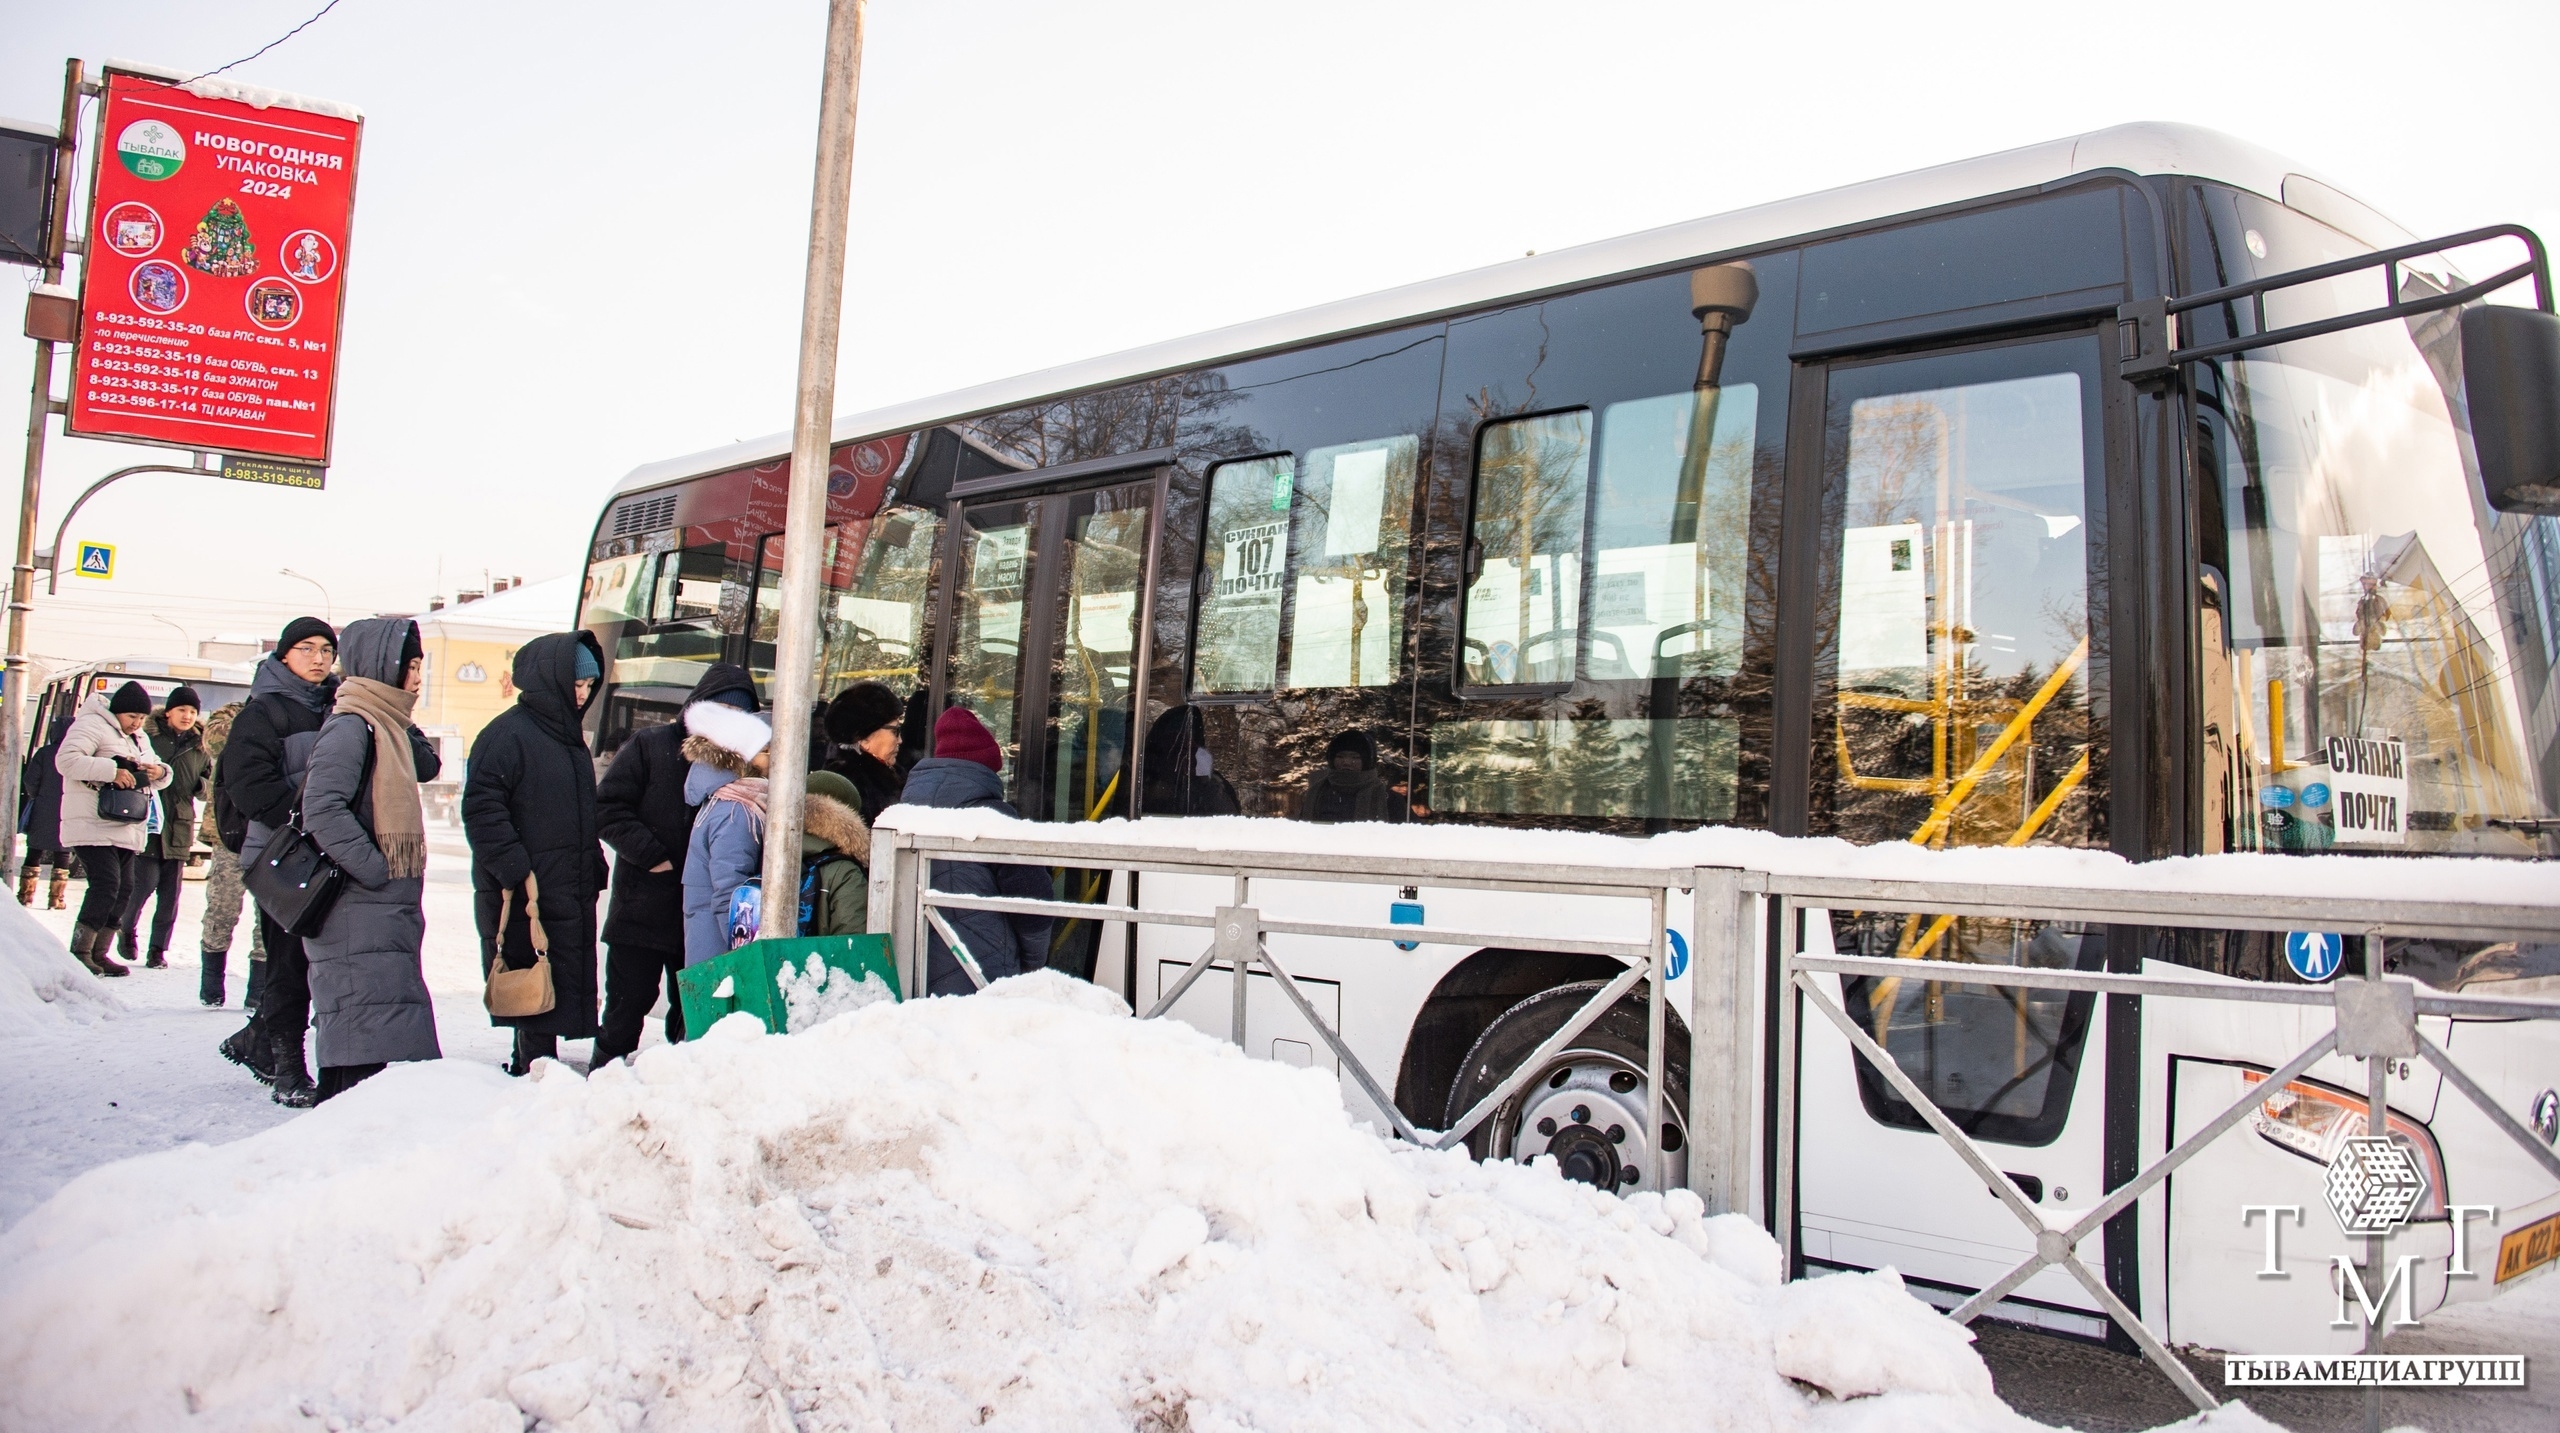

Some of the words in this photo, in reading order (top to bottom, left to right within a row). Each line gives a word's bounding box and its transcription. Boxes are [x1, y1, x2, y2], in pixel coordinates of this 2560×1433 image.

[123, 141, 179, 159] ТЫВАПАК
[194, 131, 343, 170] НОВОГОДНЯЯ
[215, 154, 318, 185] УПАКОВКА
[239, 178, 291, 200] 2024
[94, 328, 111, 337] -по
[113, 330, 189, 347] перечислению
[95, 311, 205, 335] 8-923-592-35-20
[208, 326, 231, 339] база
[233, 330, 255, 342] РПС
[256, 335, 284, 347] скл.
[288, 338, 300, 350] 5,
[303, 340, 327, 352] №1
[91, 358, 200, 380] 8-923-592-35-18
[203, 371, 227, 384] база
[228, 375, 279, 391] ЭХНАТОН
[93, 341, 202, 364] 8-923-552-35-19
[205, 356, 228, 368] база
[230, 359, 268, 375] ОБУВЬ,
[270, 366, 299, 377] скл.
[302, 369, 319, 380] 13
[89, 374, 199, 396] 8-923-383-35-17
[201, 387, 225, 400] база
[227, 391, 263, 405] ОБУВЬ
[87, 390, 197, 413] 8-923-596-17-14
[201, 404, 215, 416] ТЦ
[215, 406, 266, 421] КАРАВАН
[224, 467, 321, 488] 8-983-519-66-09
[236, 461, 274, 470] РЕКЛАМА
[288, 467, 311, 475] ЩИТЕ
[1236, 536, 1274, 577] 107
[1221, 571, 1283, 596] ПОЧТА
[2327, 736, 2404, 780] СУКПАК
[2340, 791, 2398, 833] ПОЧТА
[2526, 1224, 2551, 1265] 022
